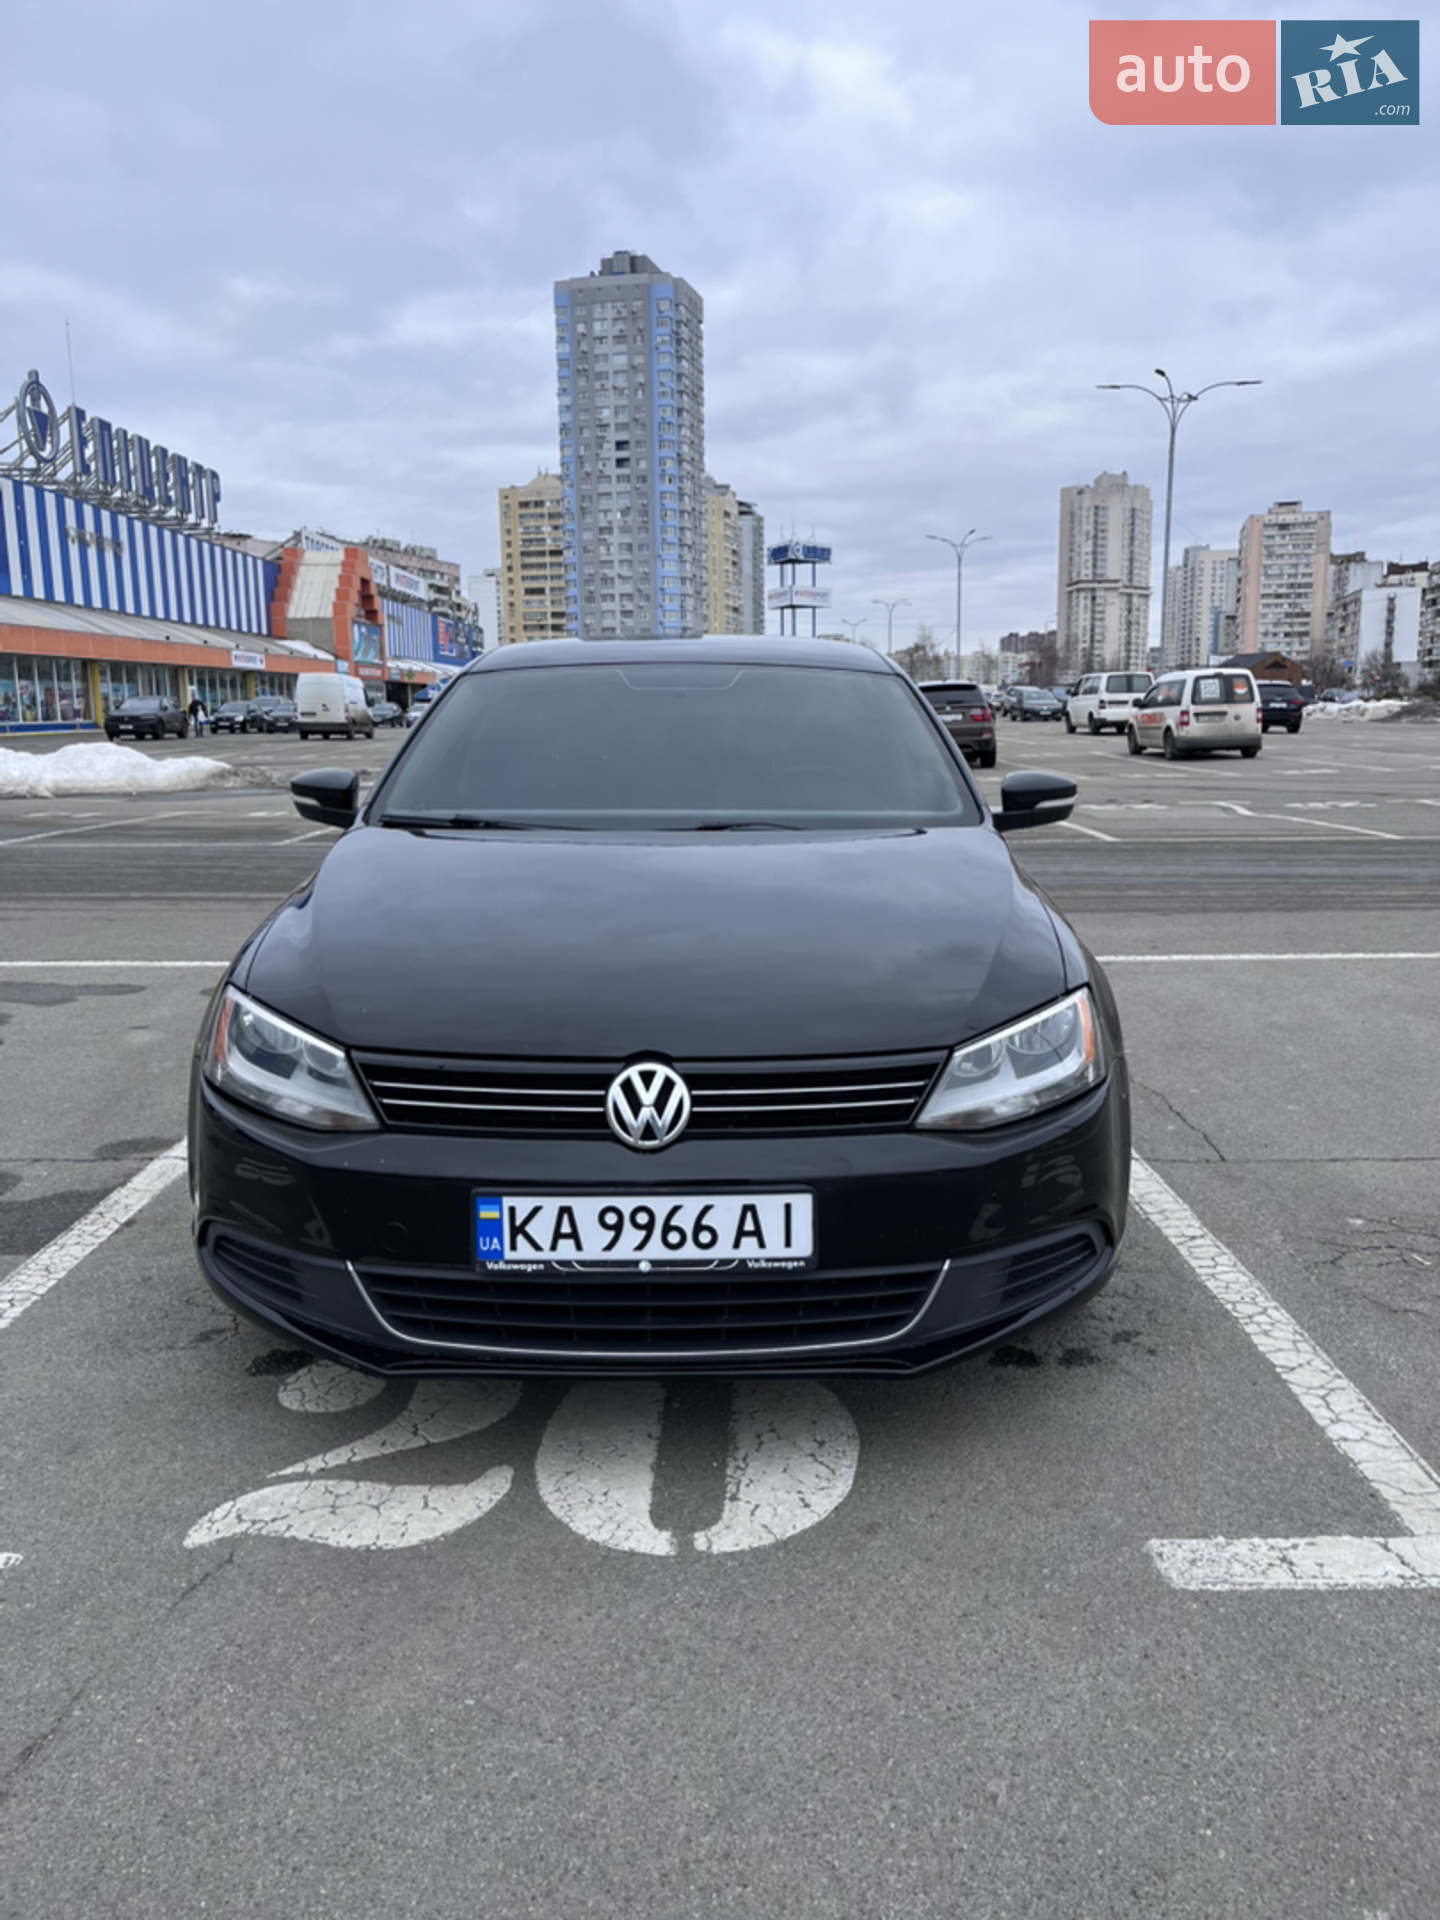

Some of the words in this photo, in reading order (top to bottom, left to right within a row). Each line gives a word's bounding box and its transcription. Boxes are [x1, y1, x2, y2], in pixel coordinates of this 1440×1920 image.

[508, 1205, 583, 1251] KA
[598, 1204, 719, 1251] 9966
[732, 1203, 792, 1250] AI
[479, 1237, 501, 1251] UA
[485, 1260, 545, 1272] Volkswagen
[746, 1258, 806, 1270] Volkswagen
